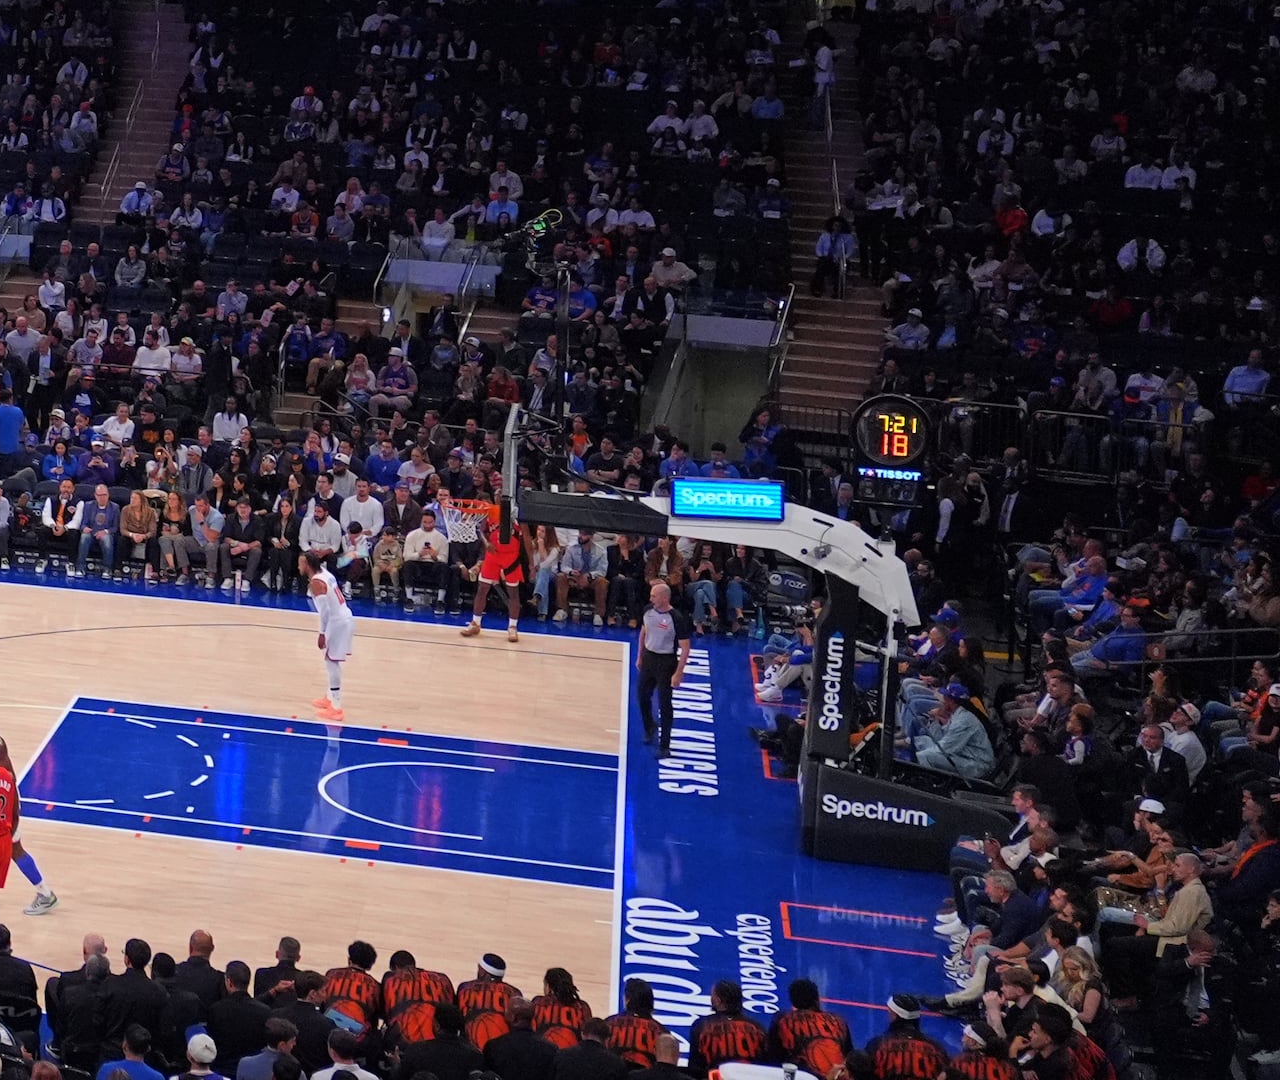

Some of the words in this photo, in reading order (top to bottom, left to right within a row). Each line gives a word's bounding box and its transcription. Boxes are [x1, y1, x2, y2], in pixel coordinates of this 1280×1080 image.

[878, 415, 918, 434] 7:21
[881, 433, 909, 458] 18
[877, 469, 922, 482] TISSOT
[681, 487, 767, 507] Spectrum
[784, 579, 807, 590] razr
[818, 636, 845, 732] Spectrum
[658, 728, 719, 797] KNICKS
[822, 794, 927, 827] Spectrum
[624, 897, 724, 971] abu
[724, 913, 787, 1015] experience
